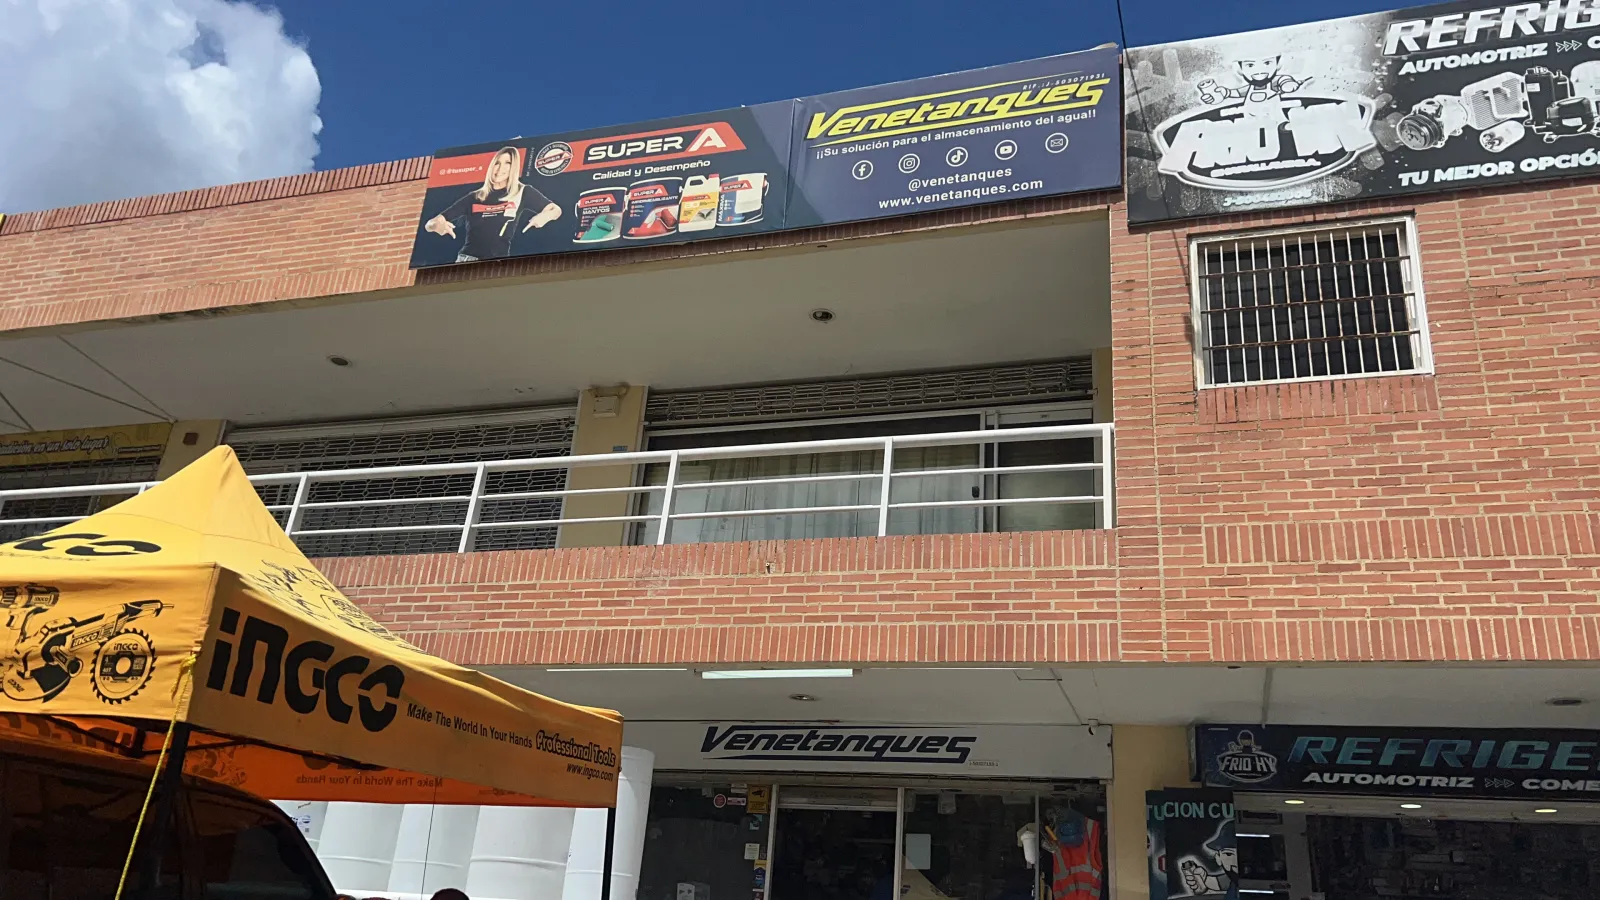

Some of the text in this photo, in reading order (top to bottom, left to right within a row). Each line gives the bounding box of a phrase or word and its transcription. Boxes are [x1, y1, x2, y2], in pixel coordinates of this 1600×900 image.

[1399, 43, 1548, 75] AUTOMOTRIZ
[807, 78, 1111, 139] Venetanques
[587, 136, 684, 161] SUPER
[688, 127, 727, 152] A
[842, 141, 889, 154] solución
[893, 138, 917, 148] para
[921, 133, 931, 142] el
[934, 120, 1031, 140] almacenamiento
[1035, 116, 1054, 126] del
[1057, 109, 1096, 123] agua!!
[593, 160, 711, 180] Calidad y Desempeño
[908, 168, 1012, 192] @venetanques
[1398, 148, 1600, 186] TU MEJOR OPCIÓ
[878, 180, 1043, 209] www.venetanques.com
[406, 703, 616, 767] Make The World In Your Hands Professional Tools
[701, 725, 977, 763] Venetanques
[1220, 756, 1252, 771] FRIO
[1287, 736, 1600, 771] REFRIGE
[566, 762, 614, 782] www.ingco.com
[1302, 772, 1474, 788] AUTOMOTRIZ
[1164, 801, 1204, 818] CION
